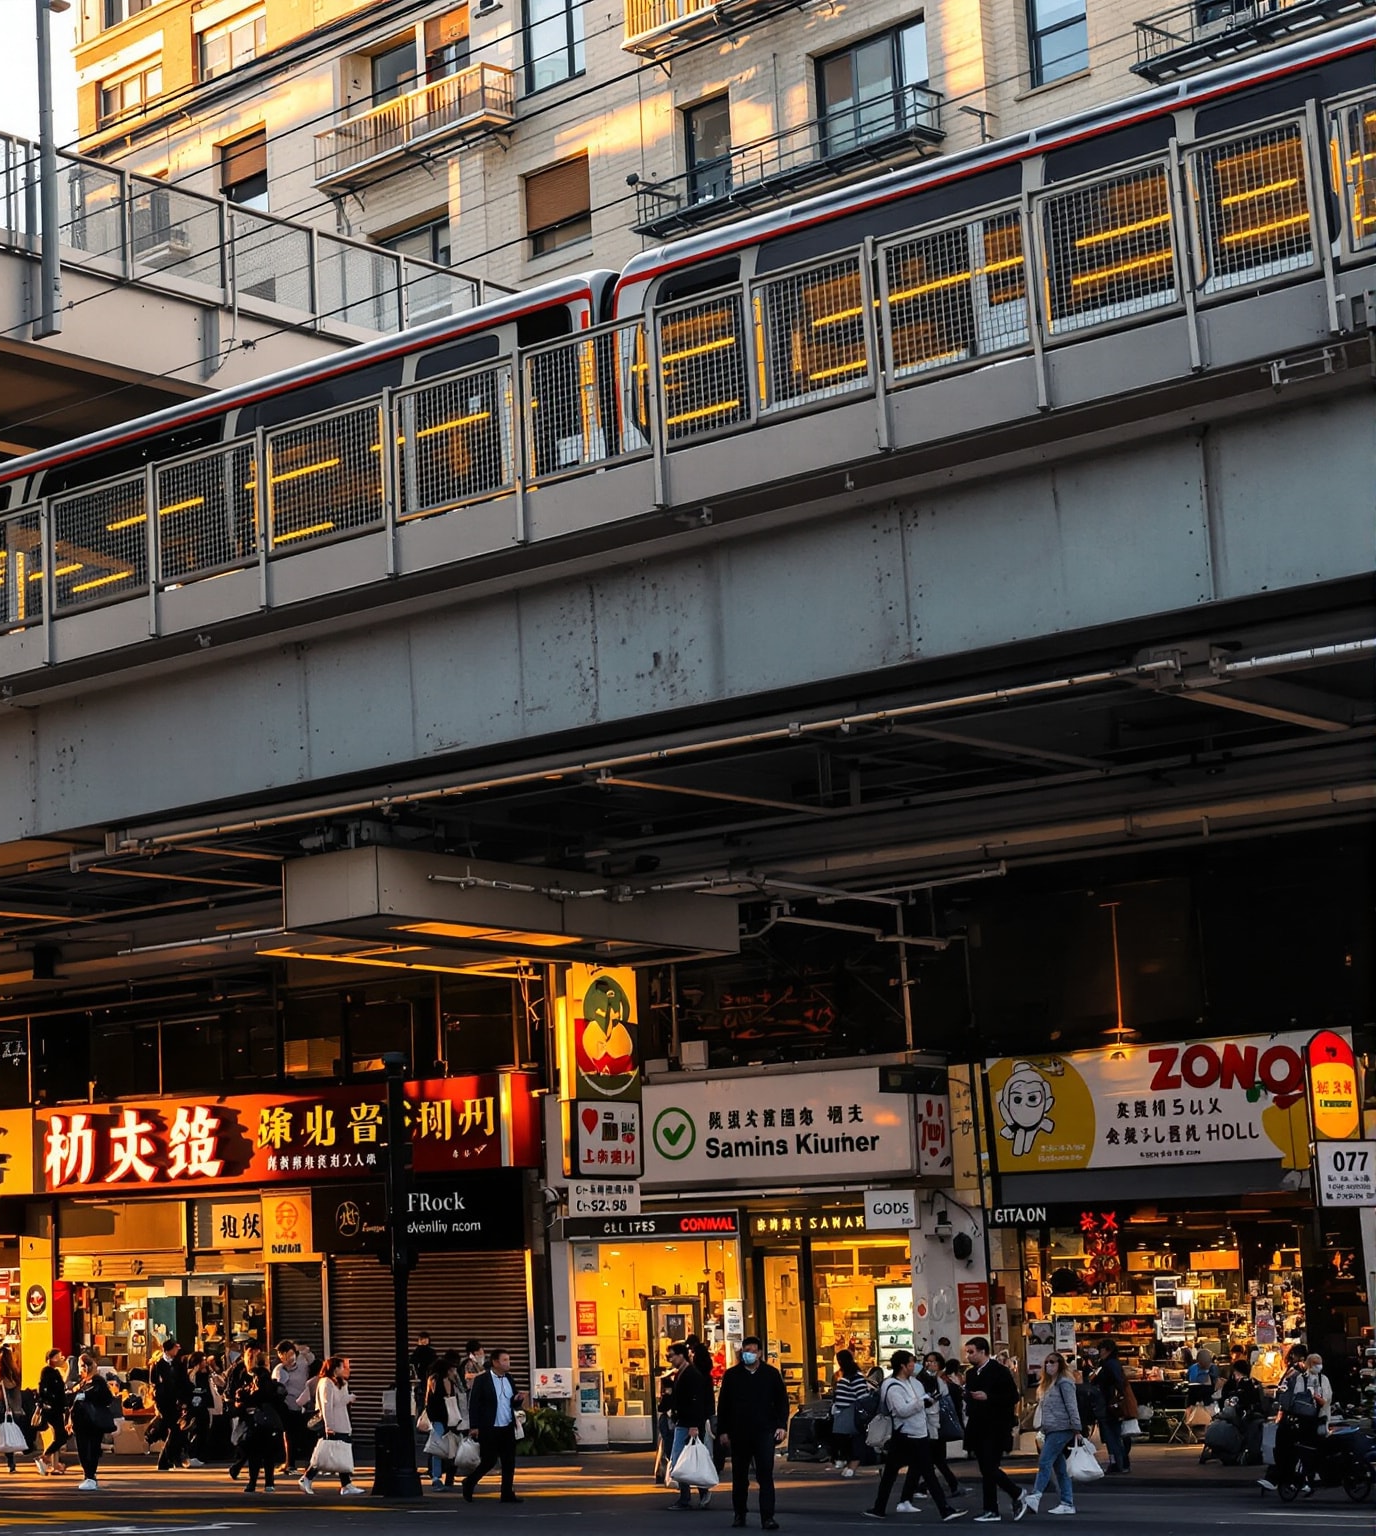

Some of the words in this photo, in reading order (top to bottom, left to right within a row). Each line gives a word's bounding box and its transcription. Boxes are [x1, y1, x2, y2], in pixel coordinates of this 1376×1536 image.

[706, 1136, 789, 1158] Samins
[1333, 1151, 1369, 1172] 077
[406, 1192, 466, 1212] FRock
[873, 1202, 910, 1215] GODS
